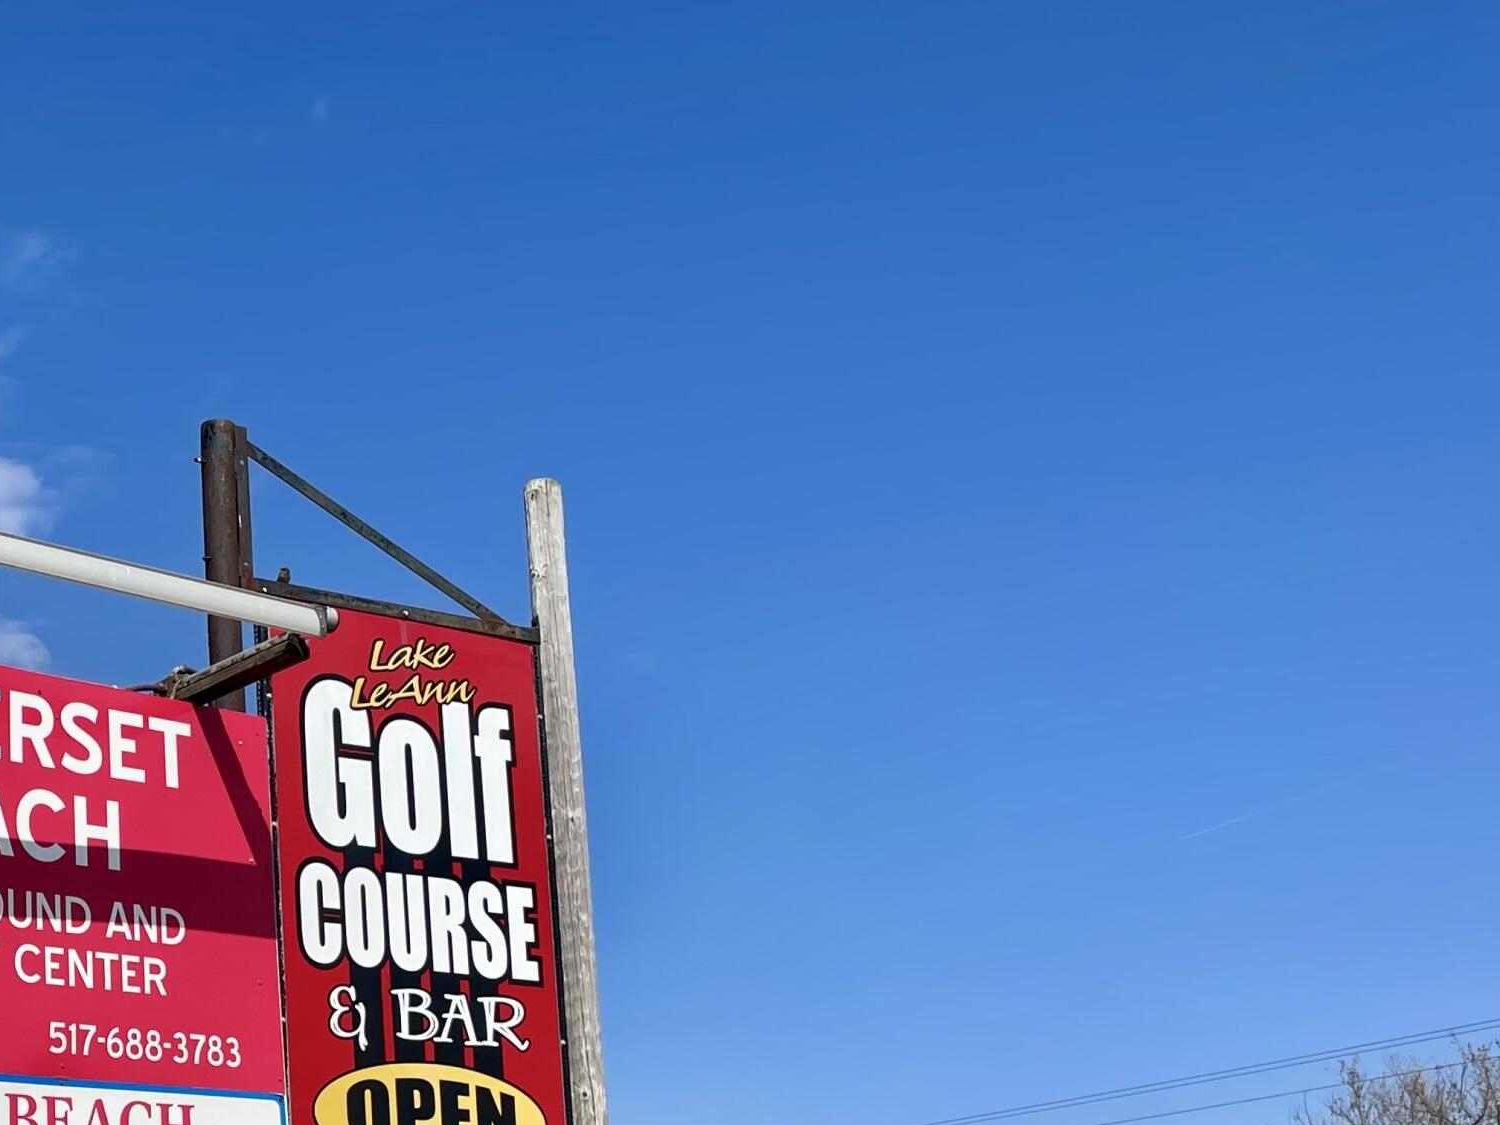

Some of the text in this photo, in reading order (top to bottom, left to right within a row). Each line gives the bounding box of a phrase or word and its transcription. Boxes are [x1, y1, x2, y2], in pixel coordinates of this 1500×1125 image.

[370, 638, 454, 671] Lake
[351, 676, 475, 708] LeAnn
[304, 679, 514, 864] Golf
[105, 901, 186, 946] AND
[299, 862, 540, 981] COURSE
[14, 943, 167, 996] CENTER
[329, 986, 530, 1051] & BAR
[49, 1021, 241, 1069] 517-688-3783
